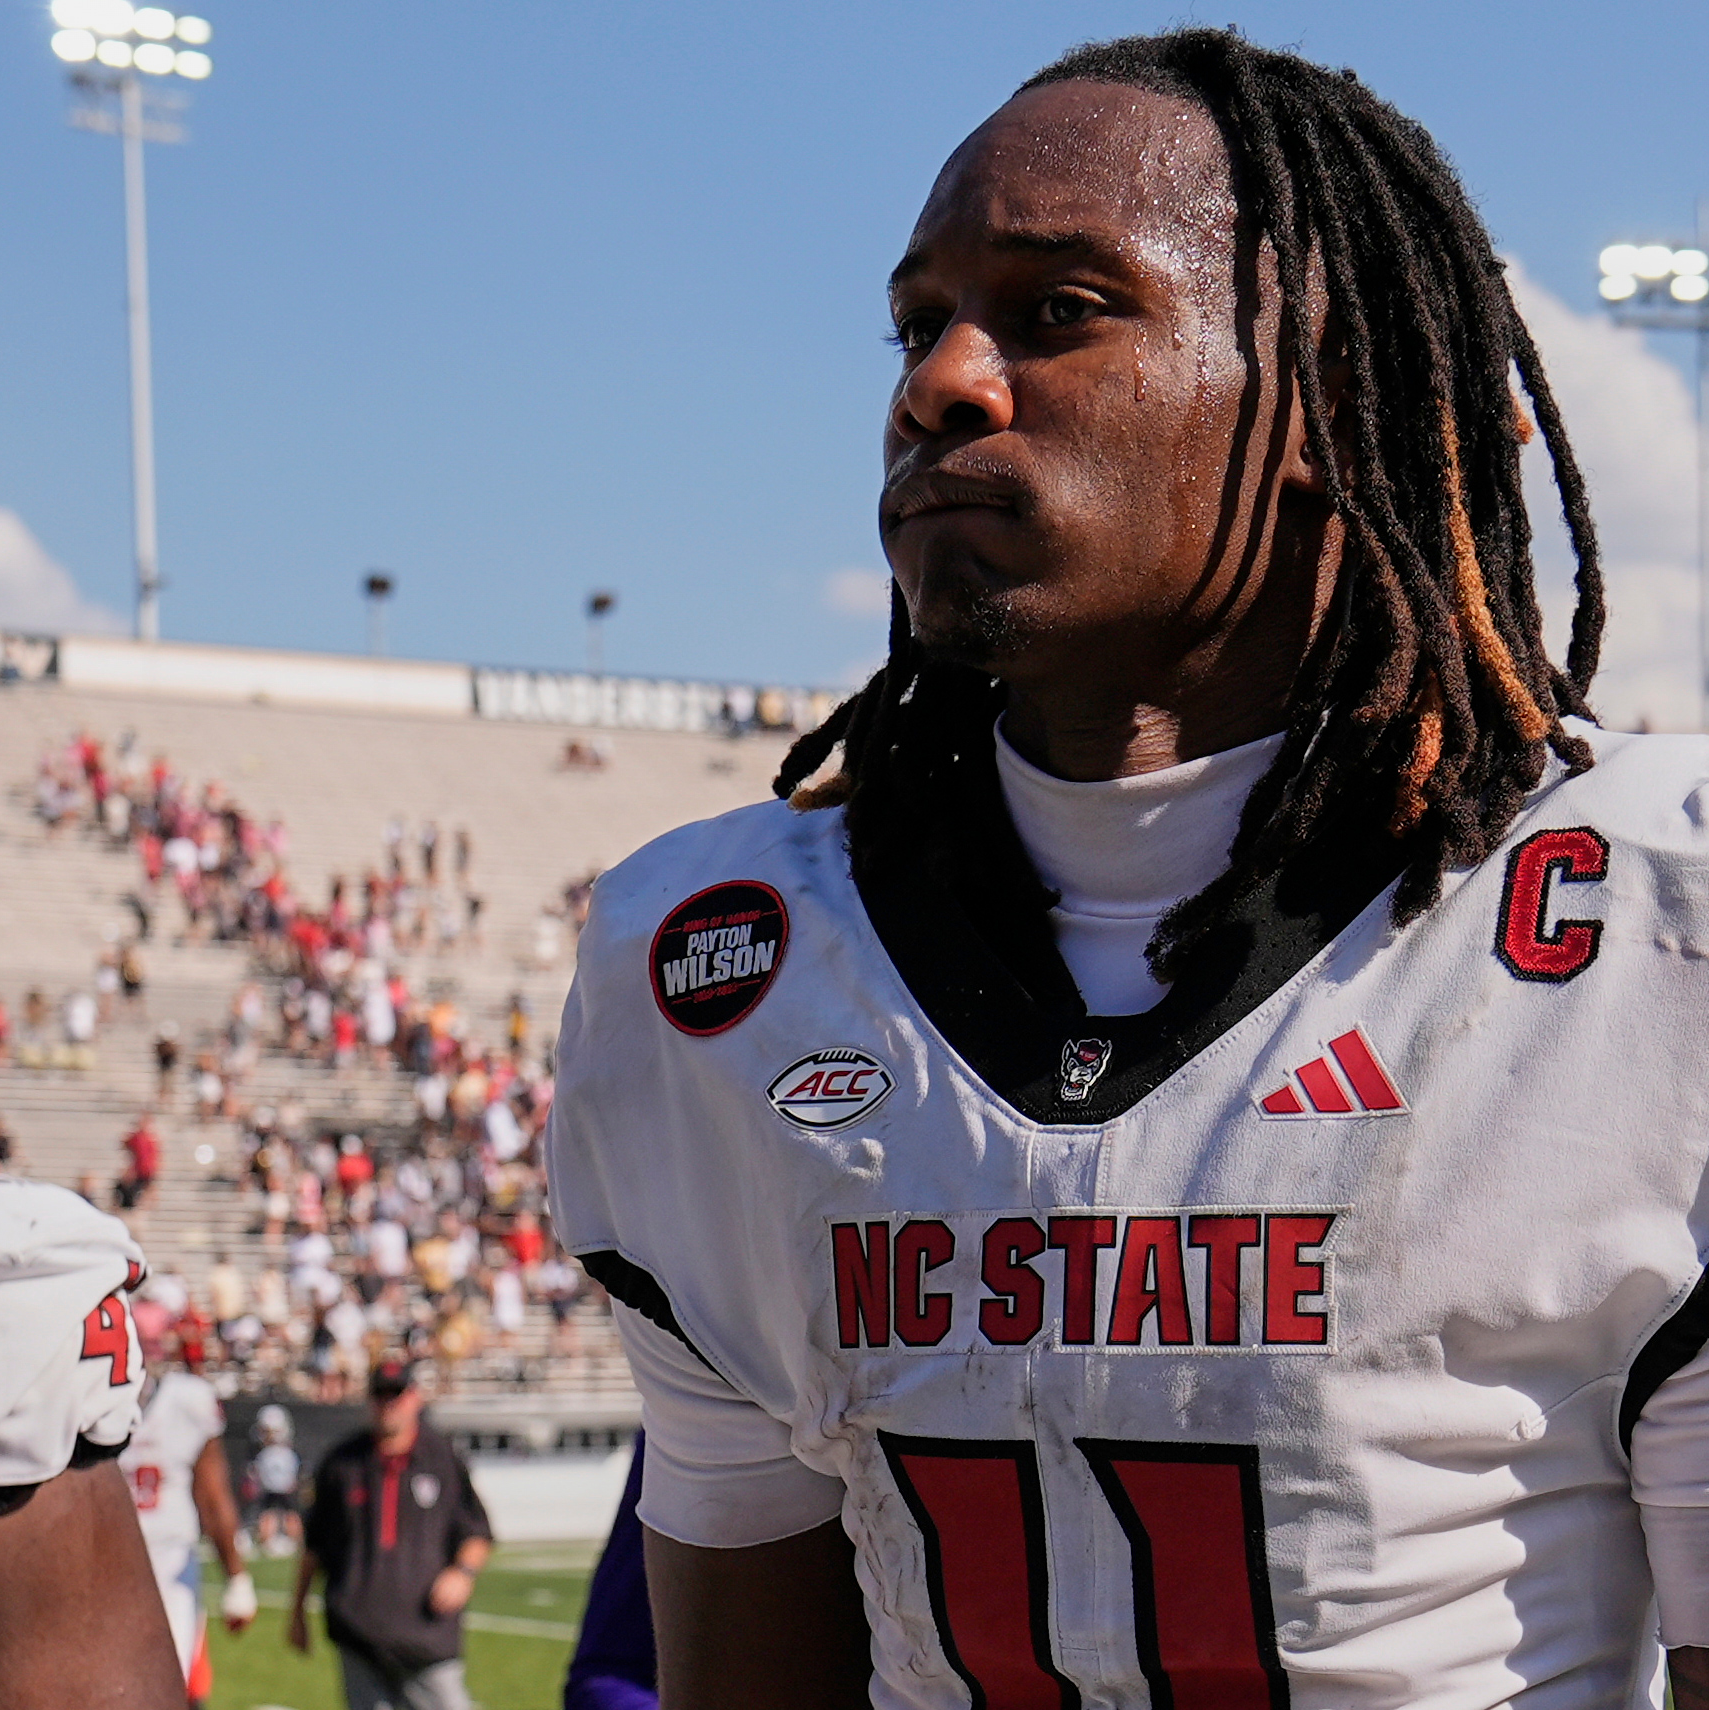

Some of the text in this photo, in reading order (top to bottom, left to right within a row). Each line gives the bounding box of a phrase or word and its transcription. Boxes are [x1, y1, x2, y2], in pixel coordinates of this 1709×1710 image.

[1496, 826, 1609, 982] C
[662, 939, 777, 998] WILSON
[686, 923, 753, 957] PAYTON
[783, 1068, 880, 1098] ACC
[831, 1213, 1338, 1349] NC STATE
